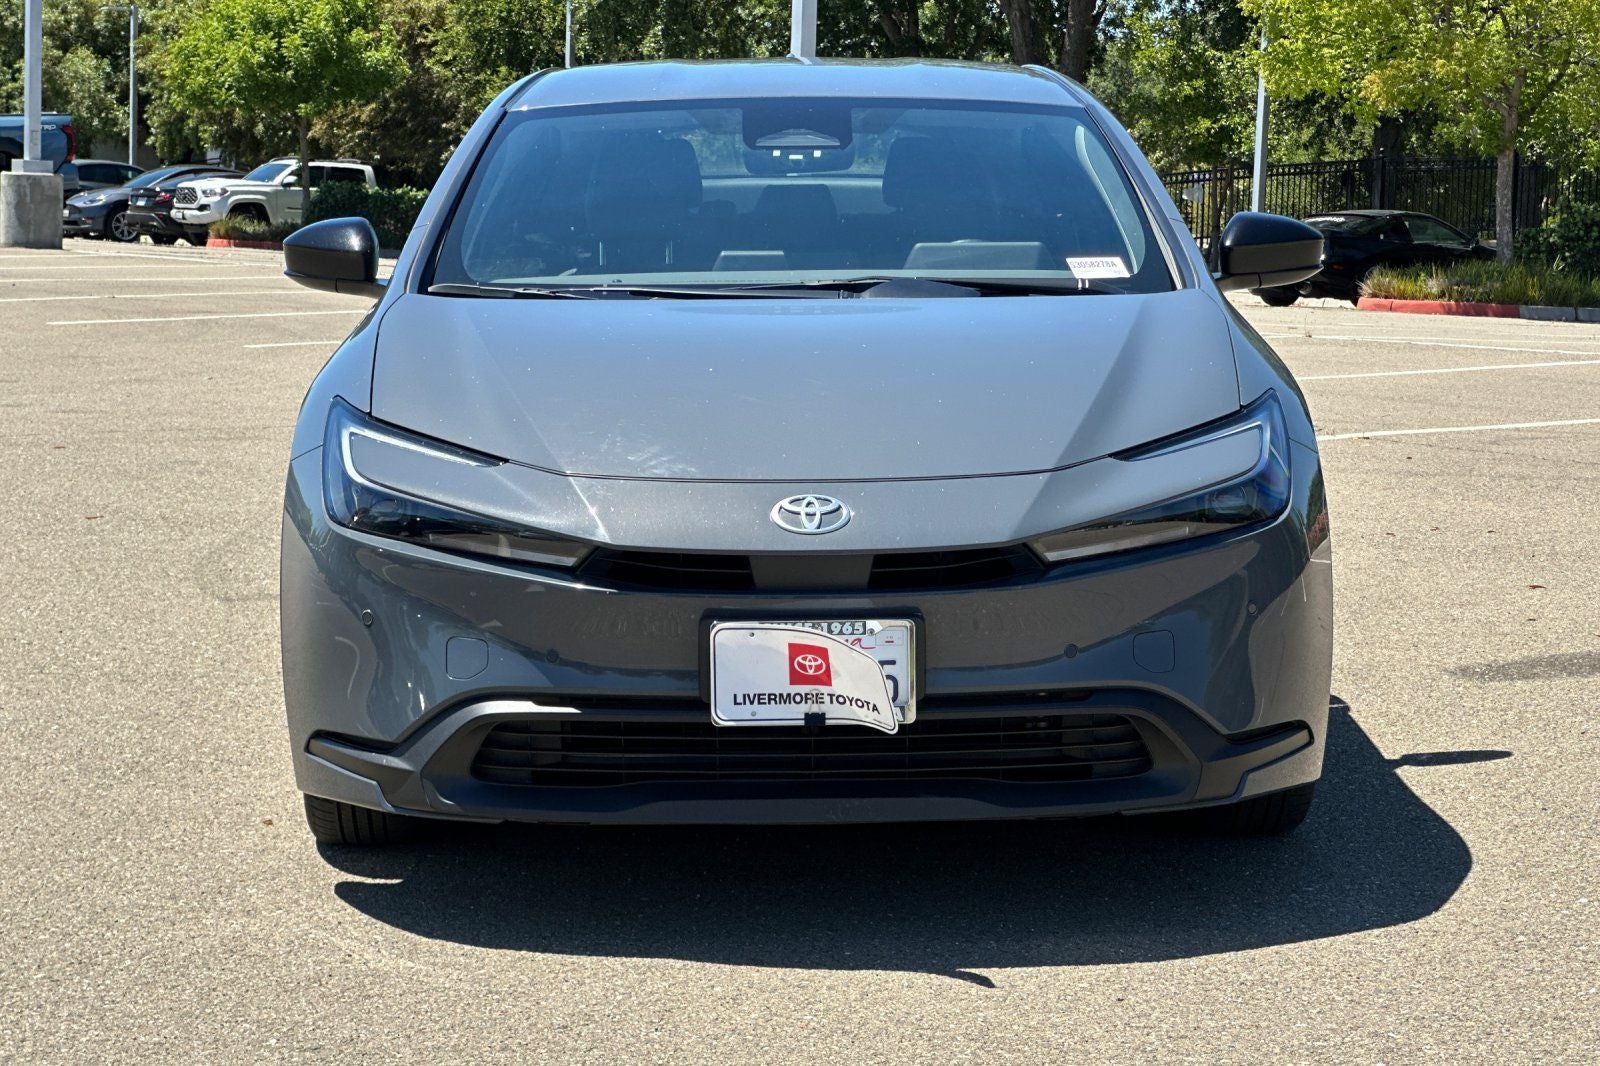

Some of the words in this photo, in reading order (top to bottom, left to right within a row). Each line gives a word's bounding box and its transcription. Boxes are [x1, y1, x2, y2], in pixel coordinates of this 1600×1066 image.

[820, 621, 864, 635] 1965
[733, 692, 825, 706] LIVERMORE
[827, 692, 881, 715] TOYOTA
